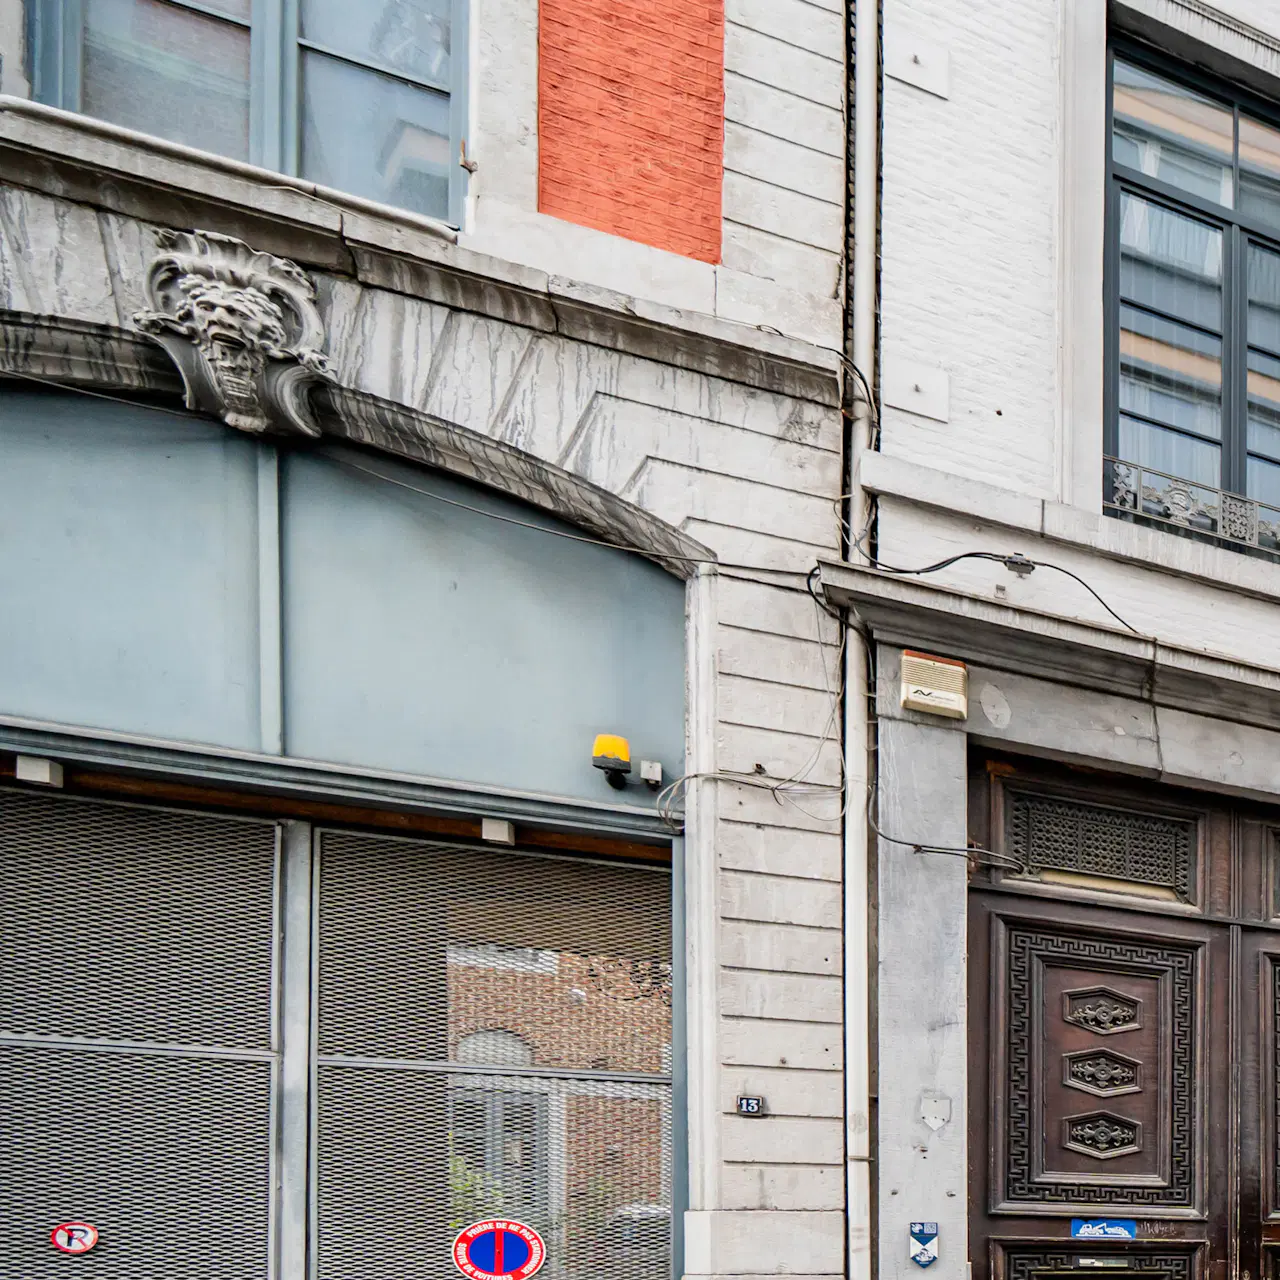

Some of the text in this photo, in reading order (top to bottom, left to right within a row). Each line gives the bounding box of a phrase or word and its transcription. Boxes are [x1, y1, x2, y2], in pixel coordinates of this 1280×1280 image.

[741, 1099, 759, 1112] 13
[466, 1222, 495, 1238] PRIÈRE
[508, 1223, 521, 1232] NE
[519, 1228, 534, 1240] PAS
[456, 1242, 469, 1265] SORTIE
[463, 1263, 476, 1273] DE
[520, 1239, 541, 1275] STATIONNER
